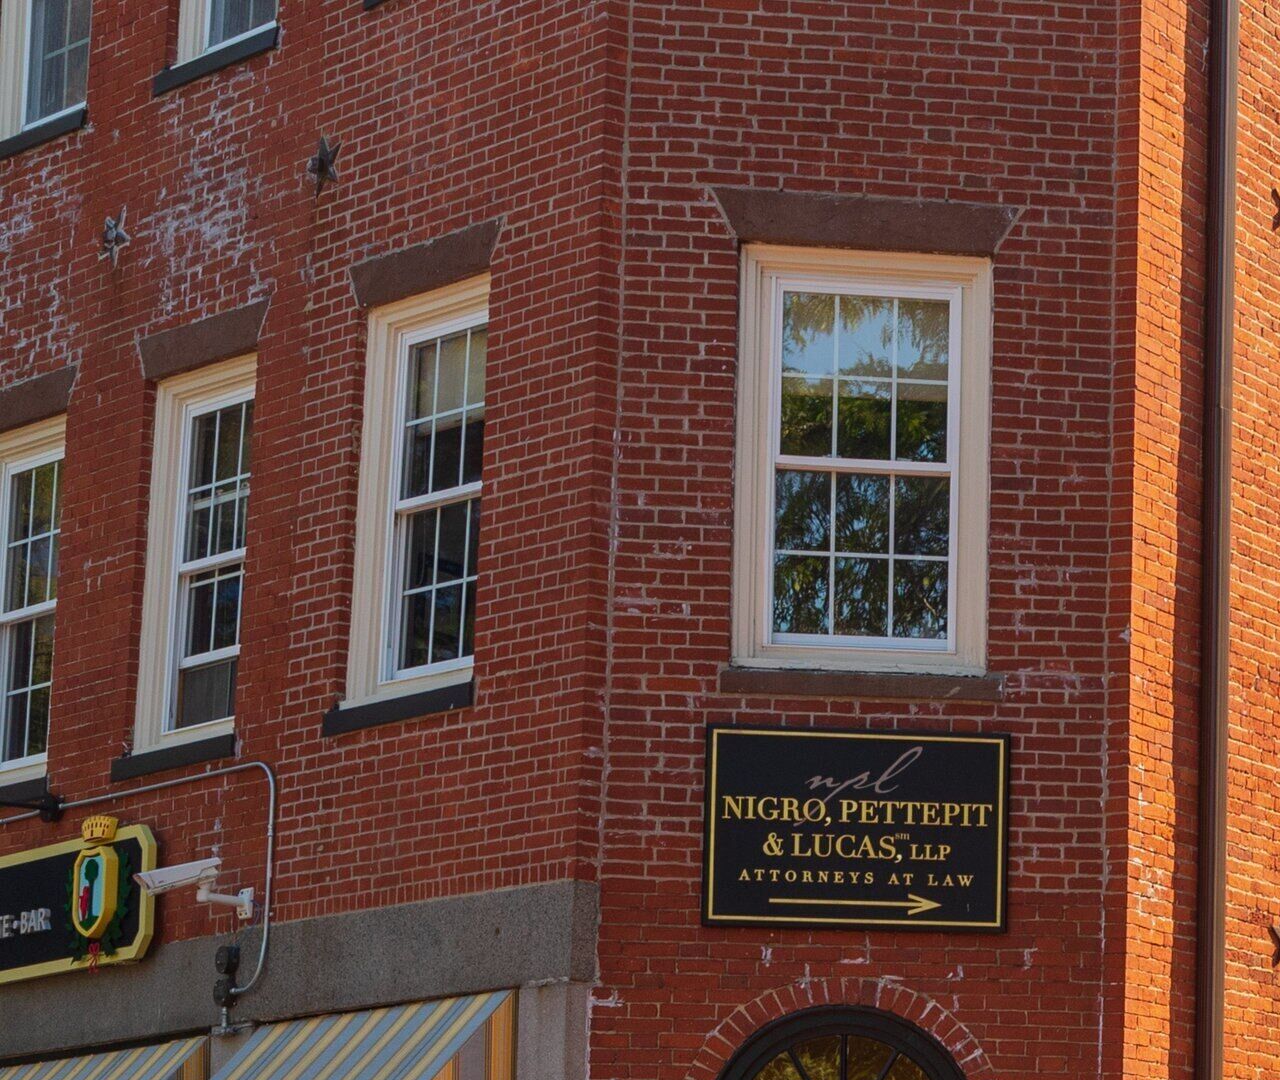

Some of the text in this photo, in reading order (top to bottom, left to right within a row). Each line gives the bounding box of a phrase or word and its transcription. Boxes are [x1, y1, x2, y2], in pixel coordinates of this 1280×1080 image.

[721, 795, 993, 828] NIGRO, PETTEPIT
[762, 831, 784, 856] &
[909, 843, 952, 861] LLP
[738, 868, 976, 888] ATTORNEYS AT LAW
[20, 907, 52, 935] BAR
